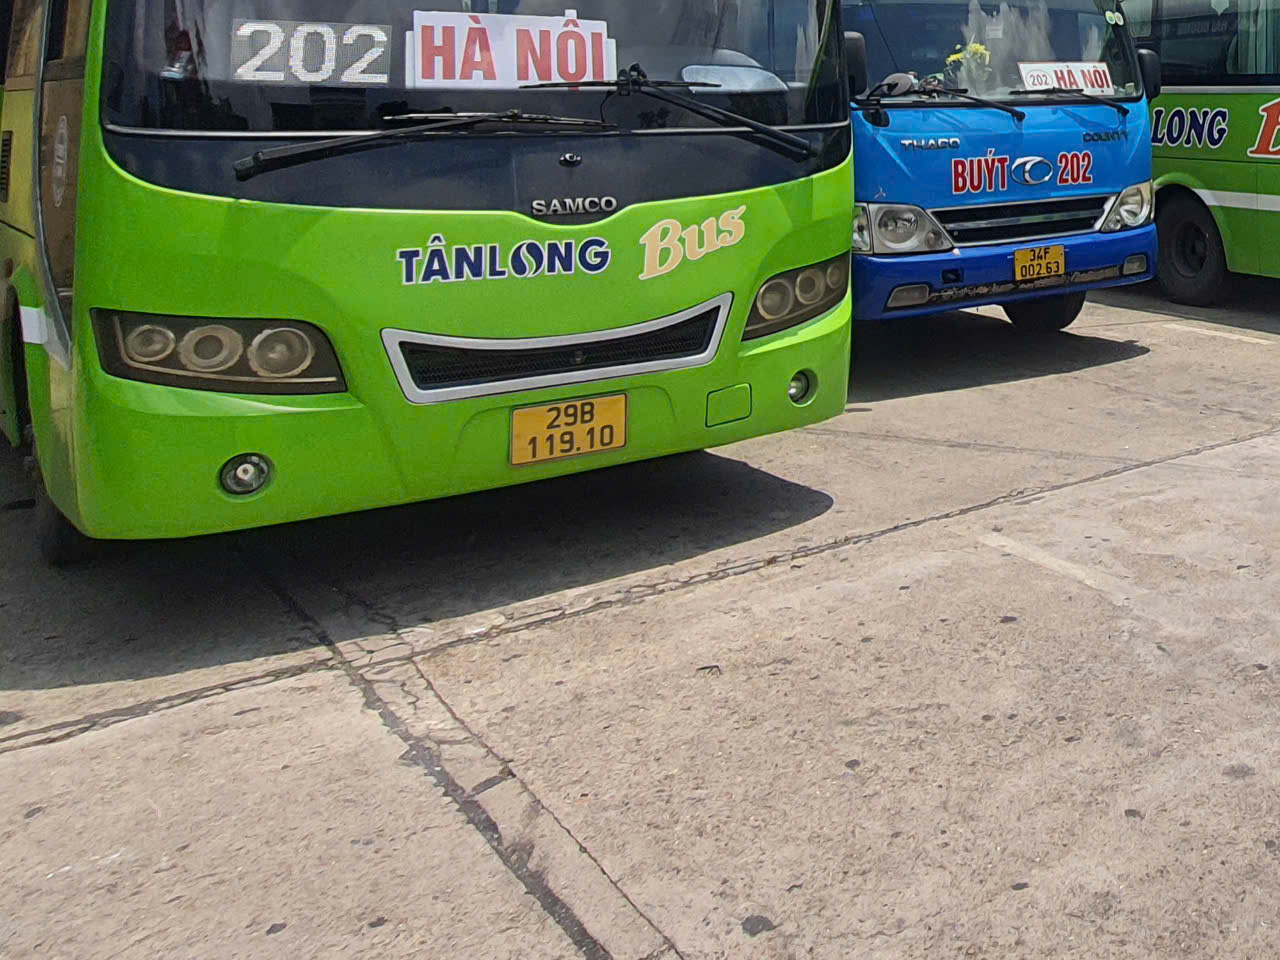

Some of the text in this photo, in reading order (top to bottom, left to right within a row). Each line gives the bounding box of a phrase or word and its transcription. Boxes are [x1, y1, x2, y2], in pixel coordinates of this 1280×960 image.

[234, 22, 388, 82] 202
[420, 15, 606, 91] HÀ NỘI
[1029, 65, 1111, 93] 202 HÀ NỘI
[1151, 107, 1229, 149] LONG
[900, 137, 961, 152] THACO
[951, 148, 1092, 195] BUÝT 202
[531, 196, 618, 216] SAMCO
[397, 204, 747, 285] TÂNLONG Bus
[1029, 246, 1051, 262] 34F
[1020, 260, 1060, 278] 002.63
[546, 401, 595, 430] 29B
[528, 424, 615, 459] 119.10
